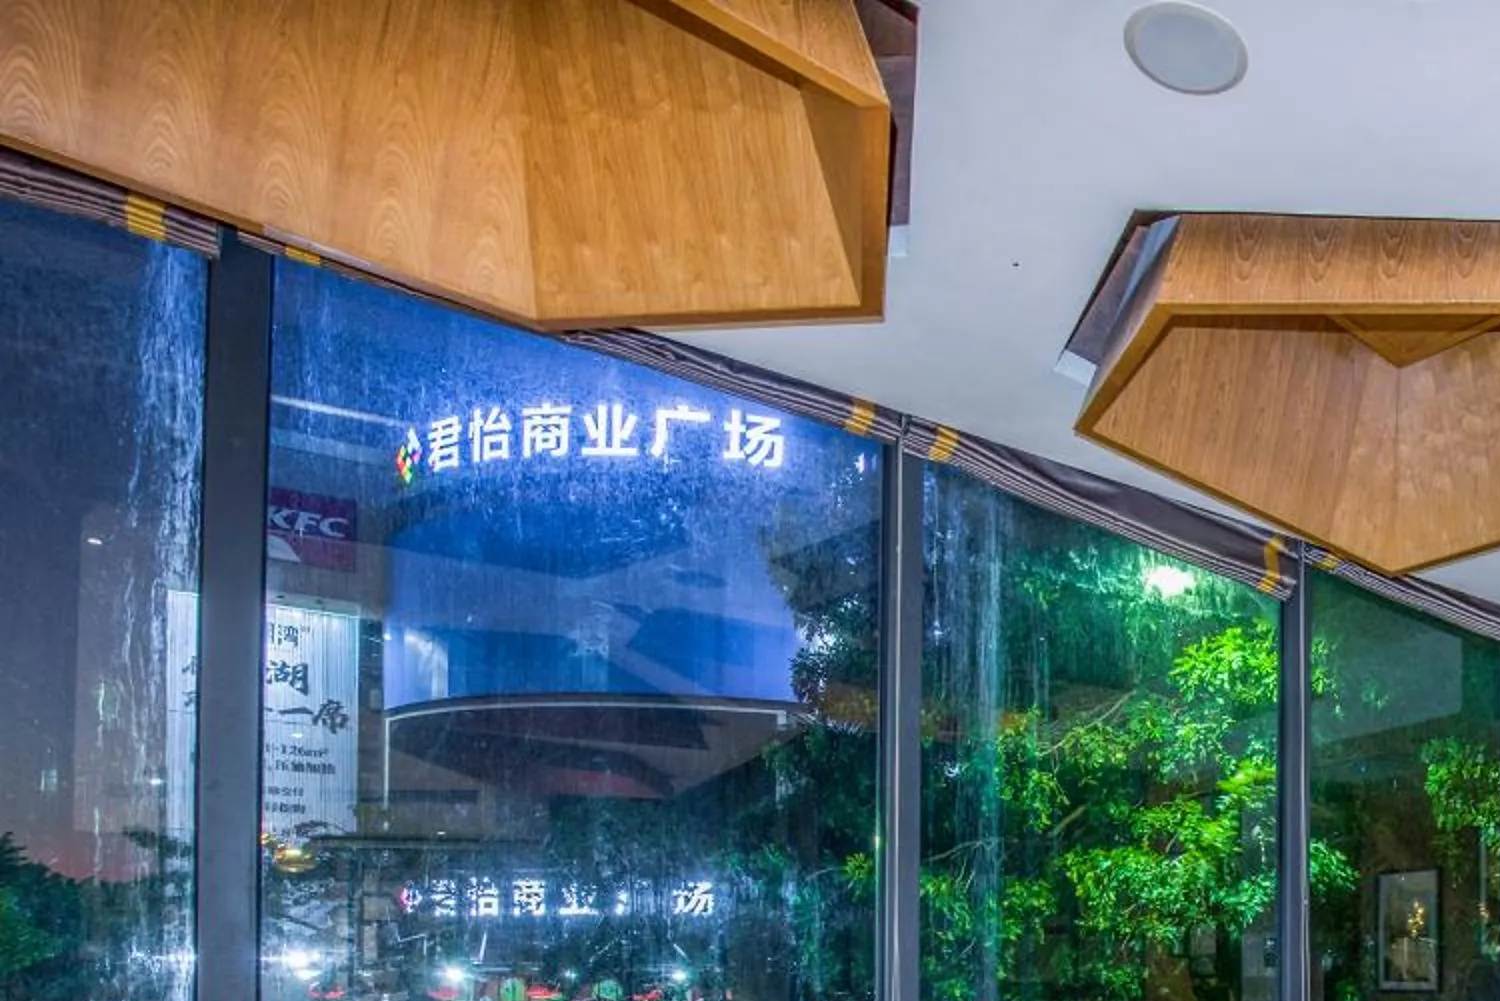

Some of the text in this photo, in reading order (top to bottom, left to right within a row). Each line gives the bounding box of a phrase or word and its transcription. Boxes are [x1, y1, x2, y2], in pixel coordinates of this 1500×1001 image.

[427, 403, 785, 472] 君怡商业广场
[267, 506, 349, 538] KFC
